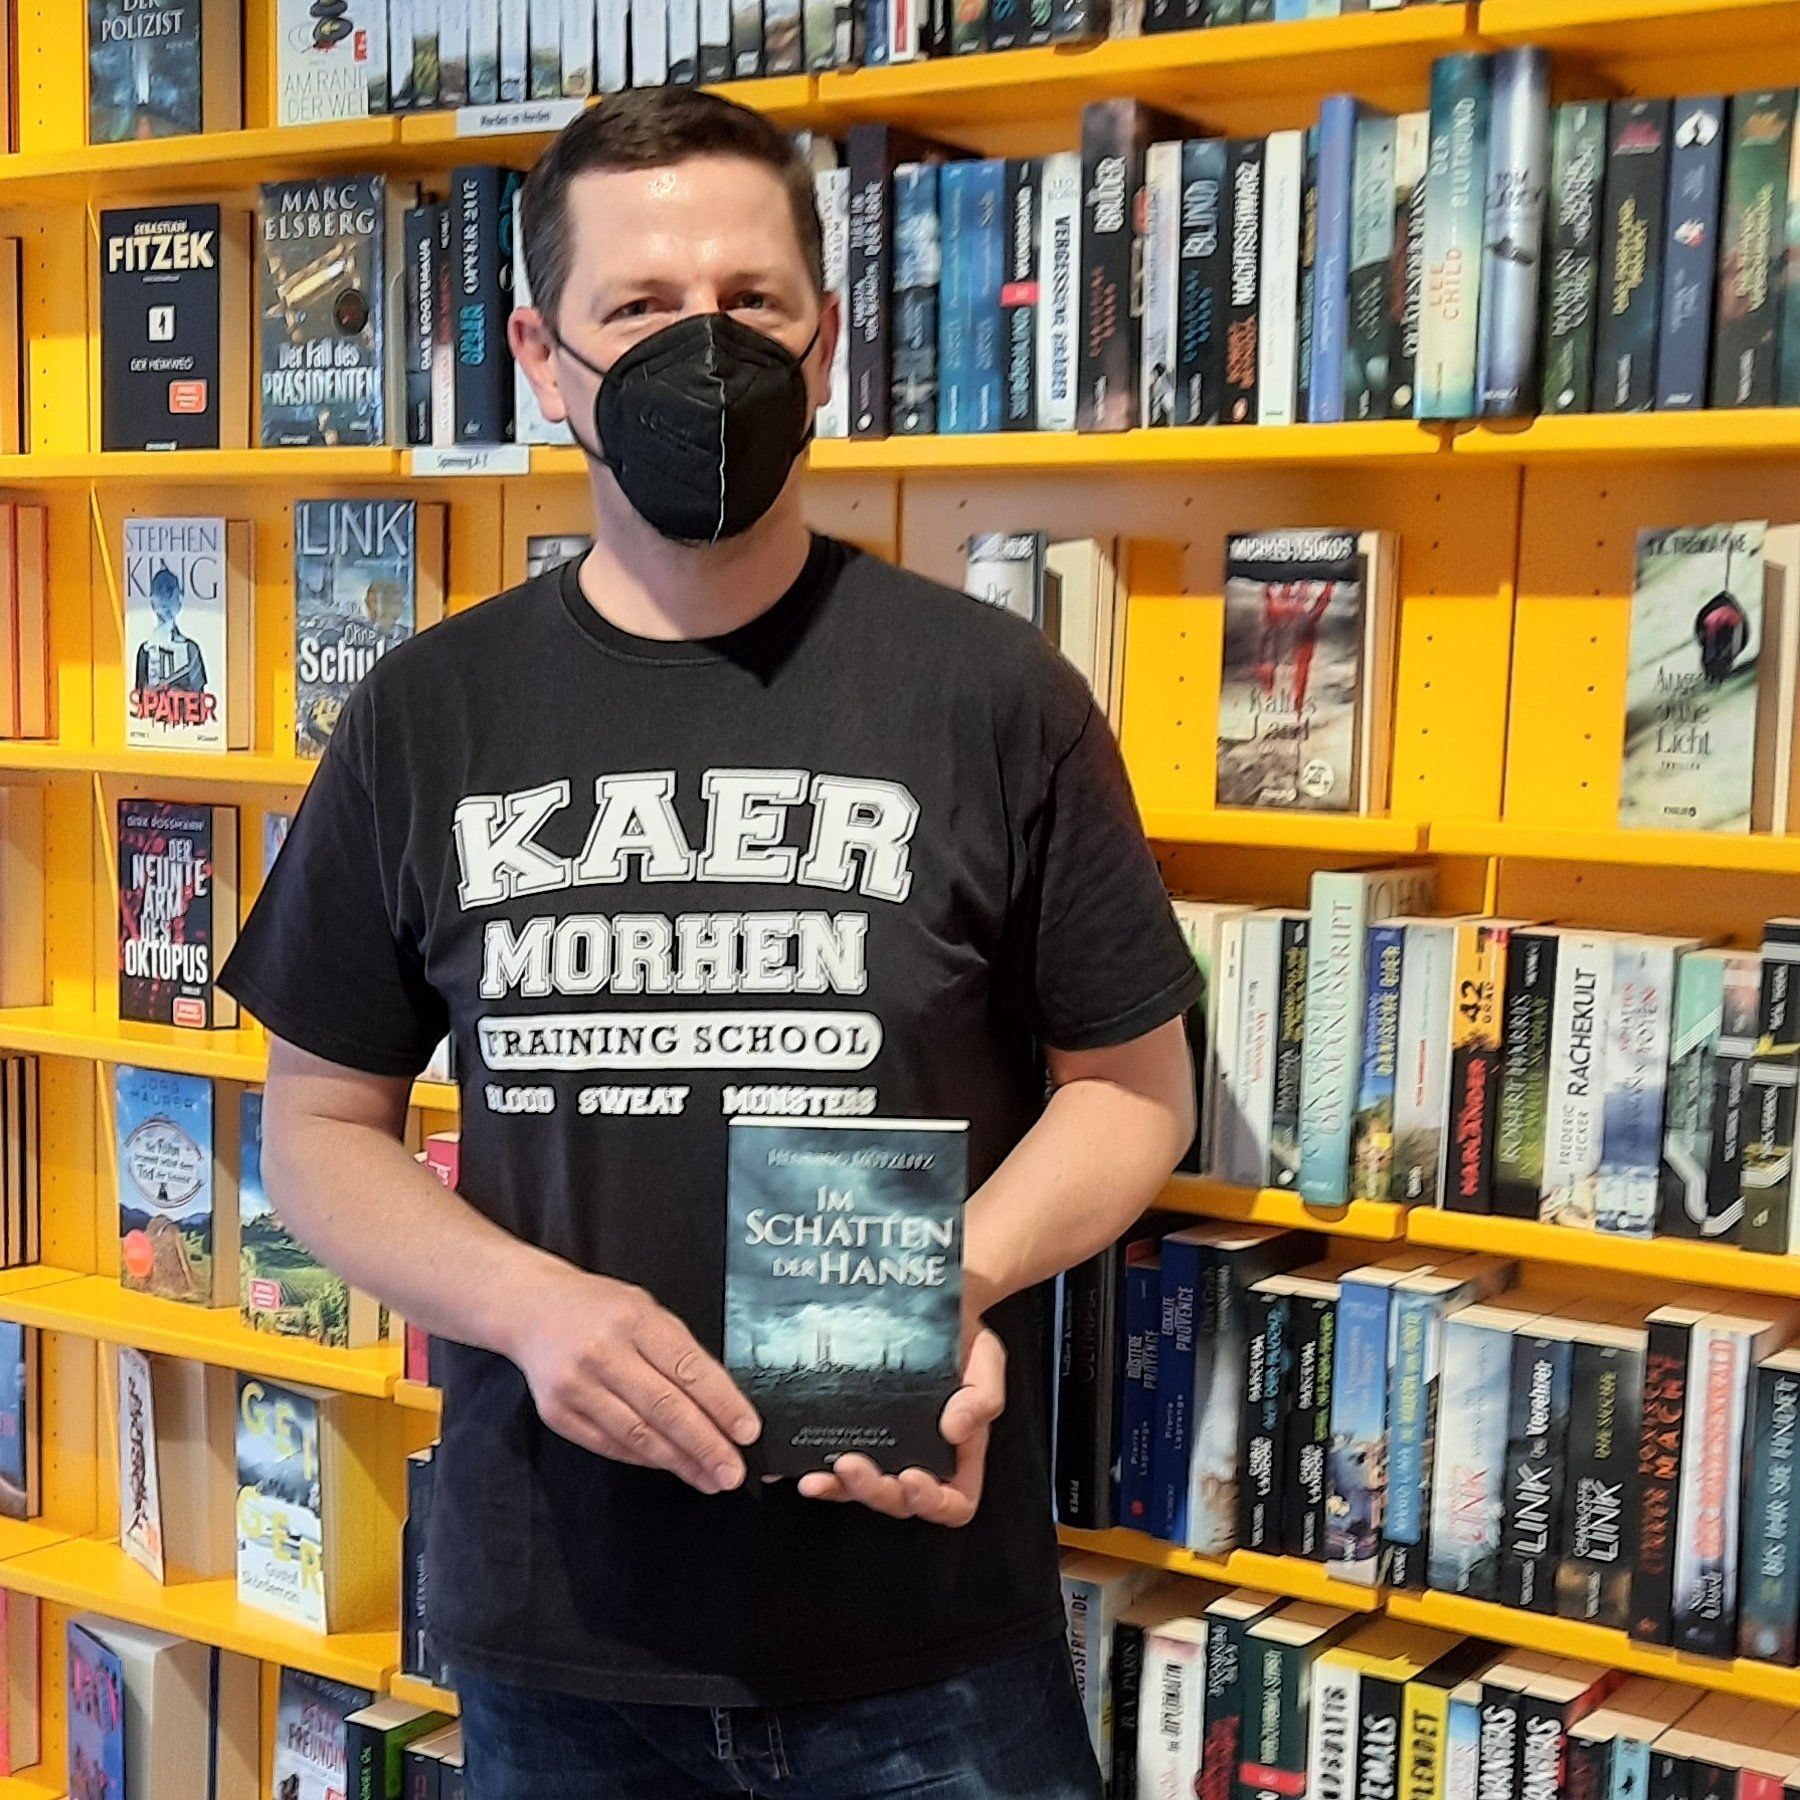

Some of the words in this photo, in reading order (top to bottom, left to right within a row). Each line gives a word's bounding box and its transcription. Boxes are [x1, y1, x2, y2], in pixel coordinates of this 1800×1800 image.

[102, 9, 184, 42] POLIZIST
[287, 97, 322, 121] DER
[281, 184, 359, 214] MARC
[1182, 179, 1218, 258] BLIND
[264, 210, 375, 241] ELSBERG
[108, 230, 215, 273] FITZEK
[1429, 264, 1444, 306] LEE
[1445, 248, 1461, 320] CHILD
[305, 339, 332, 367] Fall
[125, 526, 217, 552] STEPHEN
[301, 501, 409, 556] LINK
[127, 557, 217, 600] KING
[1656, 726, 1711, 756] Licht
[168, 838, 193, 862] DER
[452, 768, 920, 911] KAER
[124, 939, 208, 984] OKTOPUS
[479, 911, 870, 999] MORHEN
[1459, 980, 1484, 1022] 42
[483, 1024, 679, 1058] TRAINING
[693, 1021, 872, 1056] SCHOOL
[1567, 968, 1597, 1096] RACHEKULT
[579, 1084, 690, 1115] SWEAT
[1559, 1103, 1575, 1166] FREDERIC
[1575, 1110, 1589, 1162] HECKER
[744, 1208, 954, 1249] SCHATTEN
[818, 1250, 947, 1287] HANSE
[1175, 1286, 1194, 1351] PROVENCE
[1142, 1330, 1159, 1389] PROVENCE
[1450, 1467, 1488, 1545] LINK
[1512, 1463, 1553, 1555] LINK
[1587, 1479, 1623, 1562] LINK
